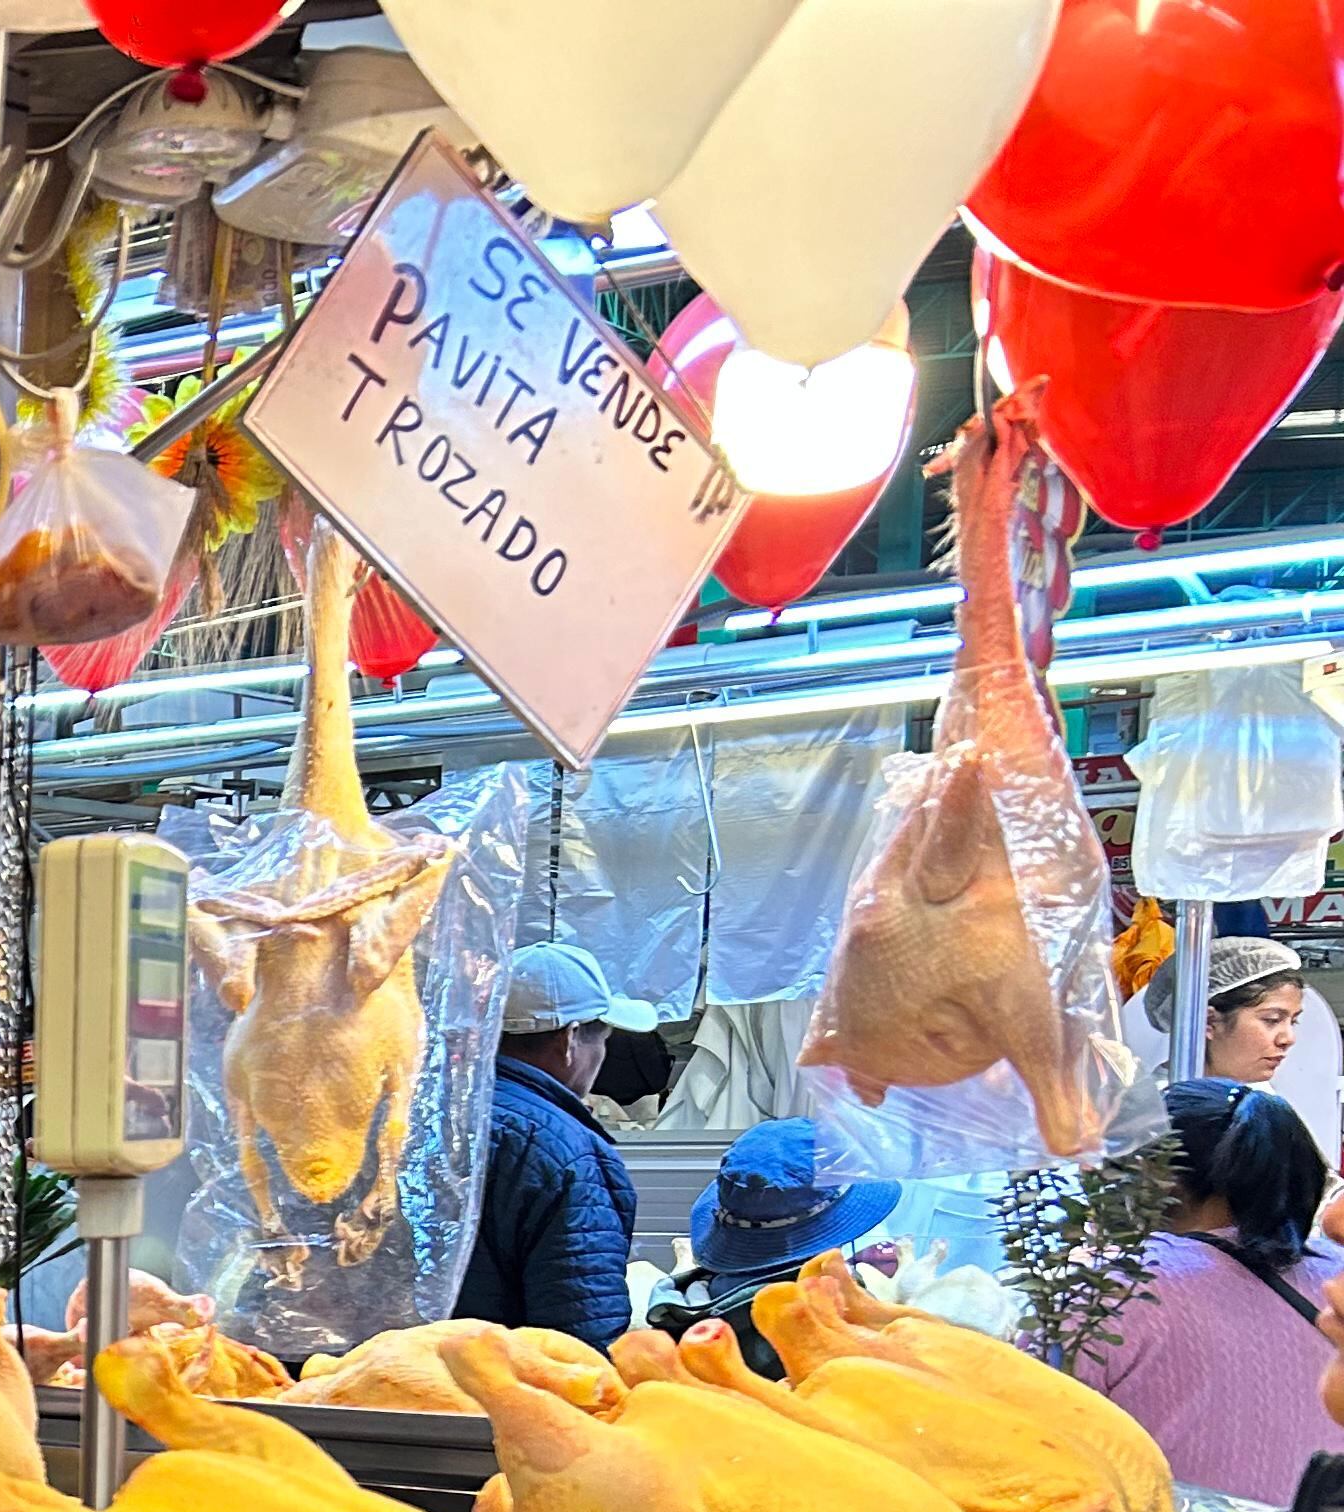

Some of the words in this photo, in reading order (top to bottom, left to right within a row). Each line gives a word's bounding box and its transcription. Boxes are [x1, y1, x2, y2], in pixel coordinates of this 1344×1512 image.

[370, 262, 558, 465] PAVITA
[468, 237, 549, 330] SE
[558, 317, 686, 473] VENDE
[342, 353, 567, 597] TROZADO
